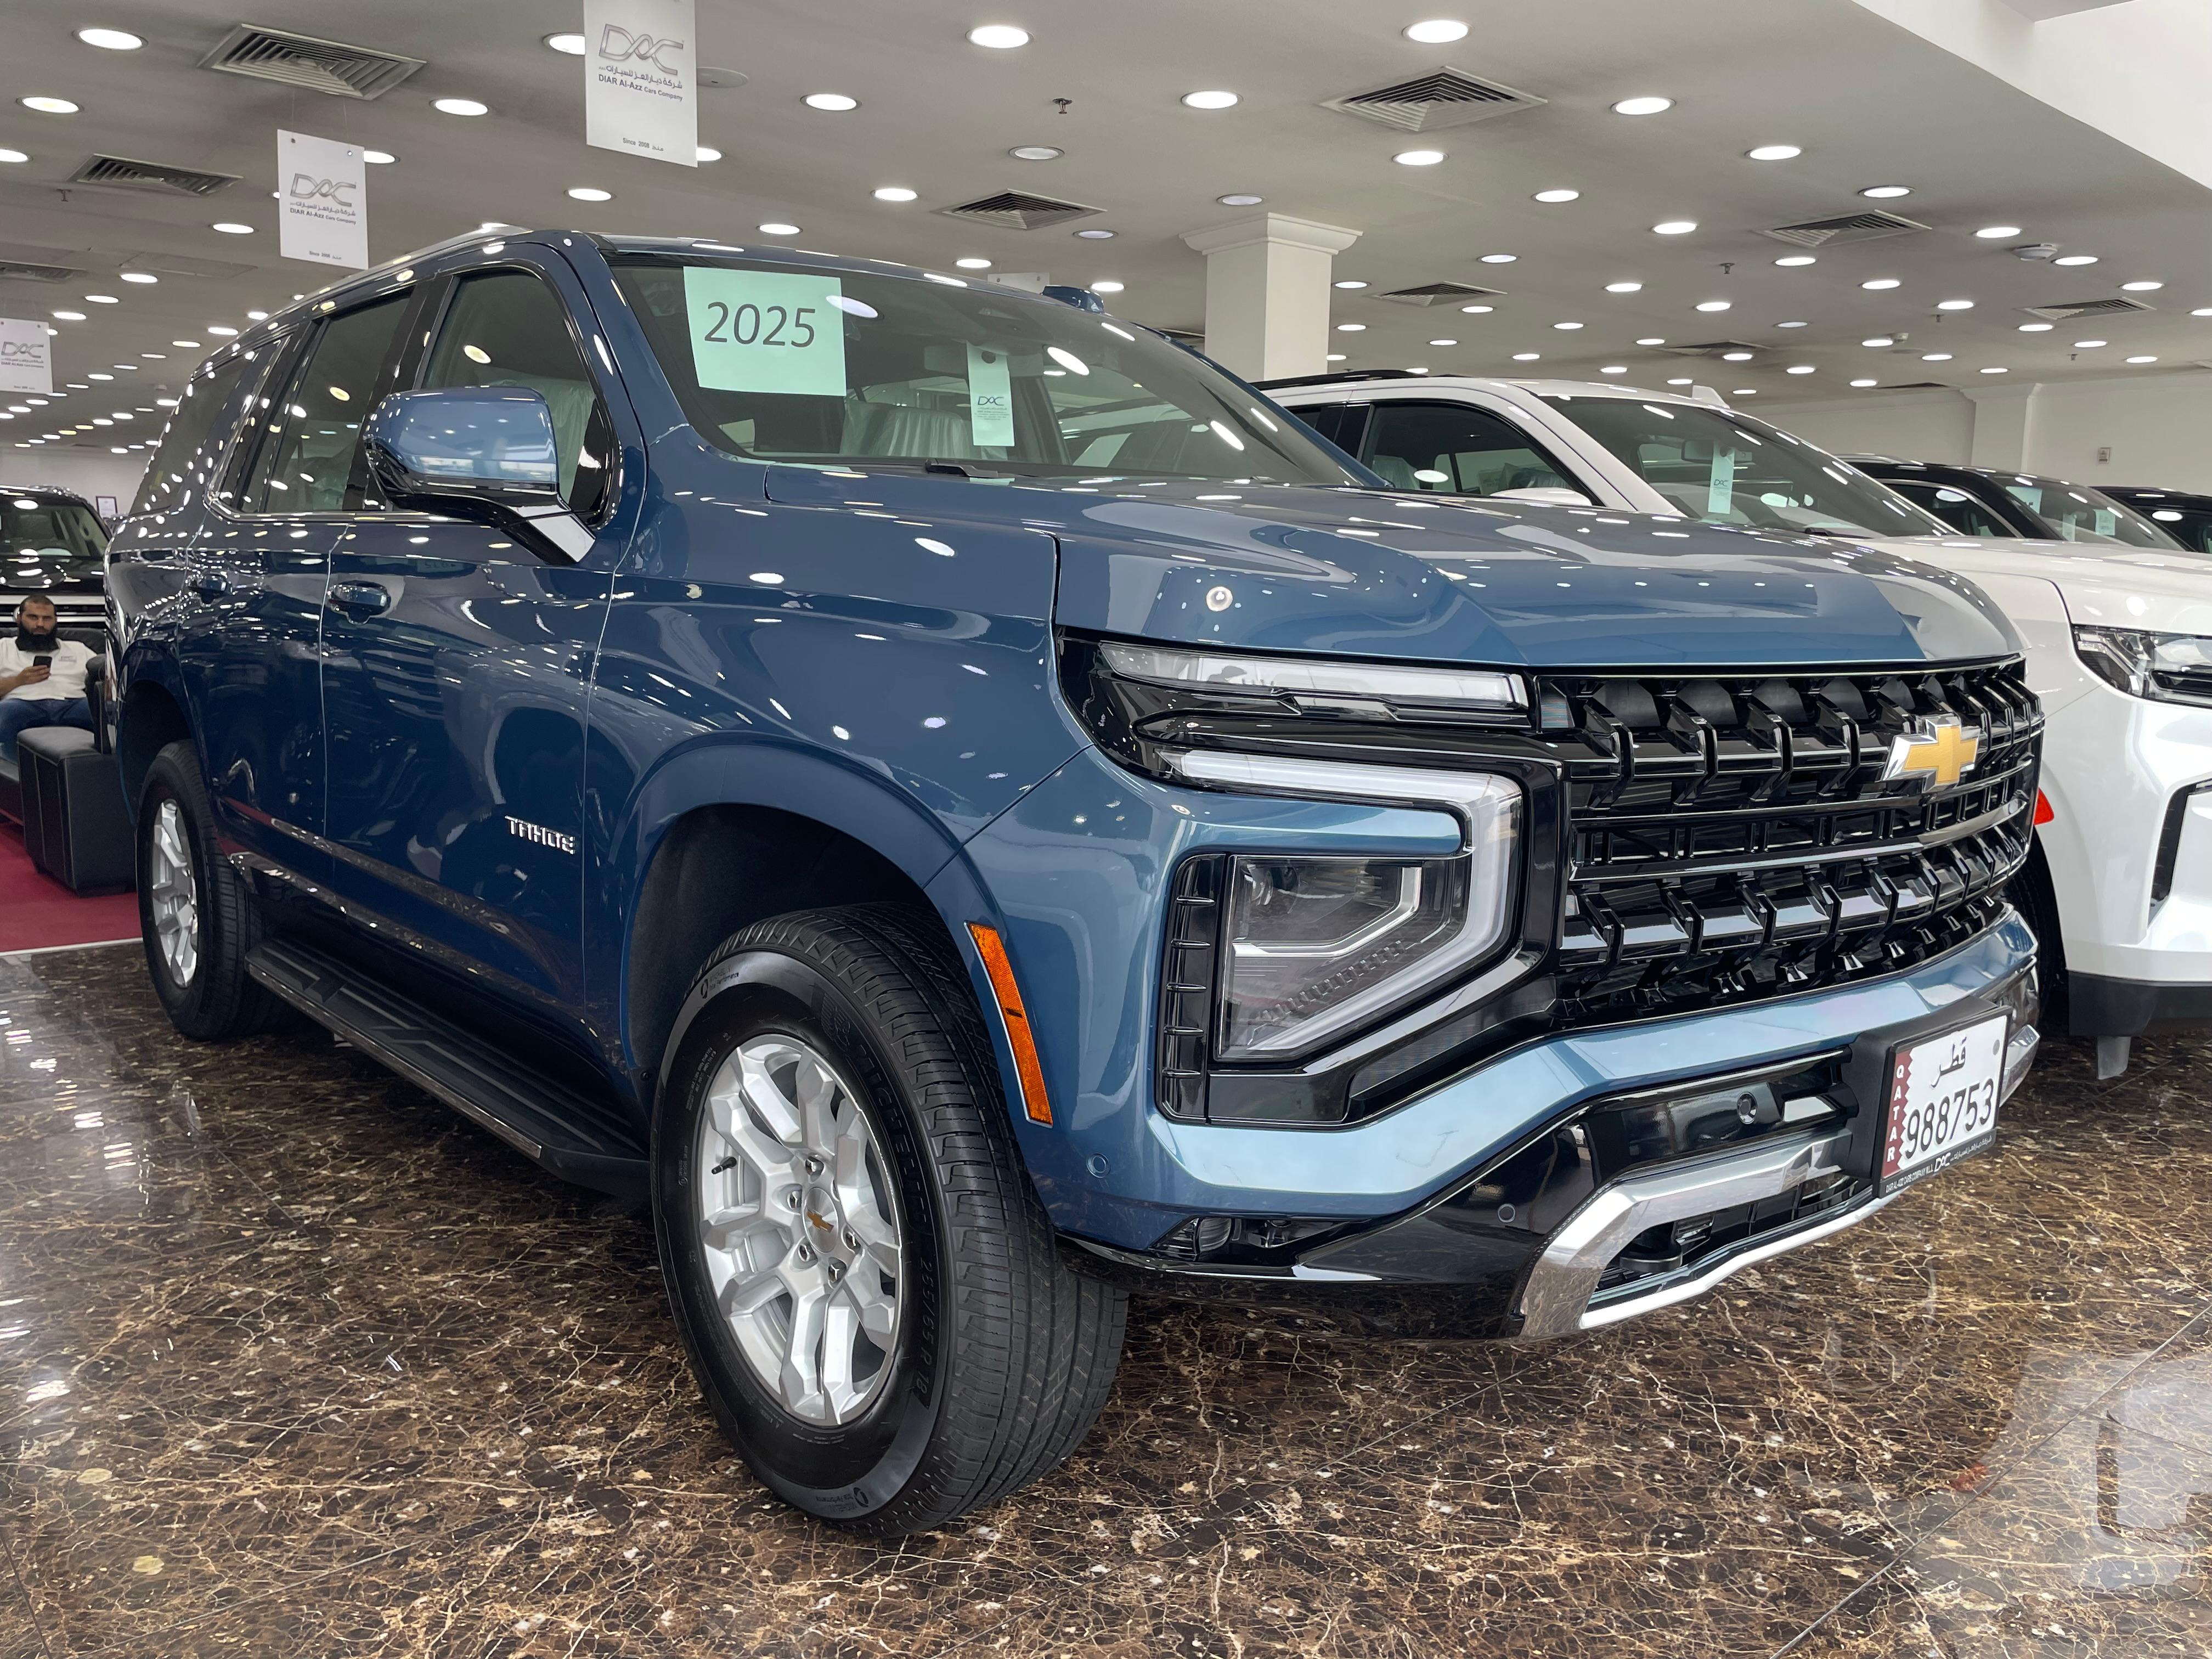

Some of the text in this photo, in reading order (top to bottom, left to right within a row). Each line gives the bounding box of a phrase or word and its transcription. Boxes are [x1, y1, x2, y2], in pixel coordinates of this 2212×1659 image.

[599, 74, 617, 85] DIAR
[619, 80, 642, 91] Al-Azz
[658, 90, 683, 101] Company
[606, 65, 633, 77] للسيارات
[663, 78, 682, 89] شركة
[623, 138, 636, 146] Since
[704, 301, 816, 348] 2025
[504, 815, 575, 855] TAHOE
[1931, 1036, 1967, 1088] قطر
[1887, 1064, 1904, 1163] QATAR
[1905, 1078, 1994, 1160] 988753
